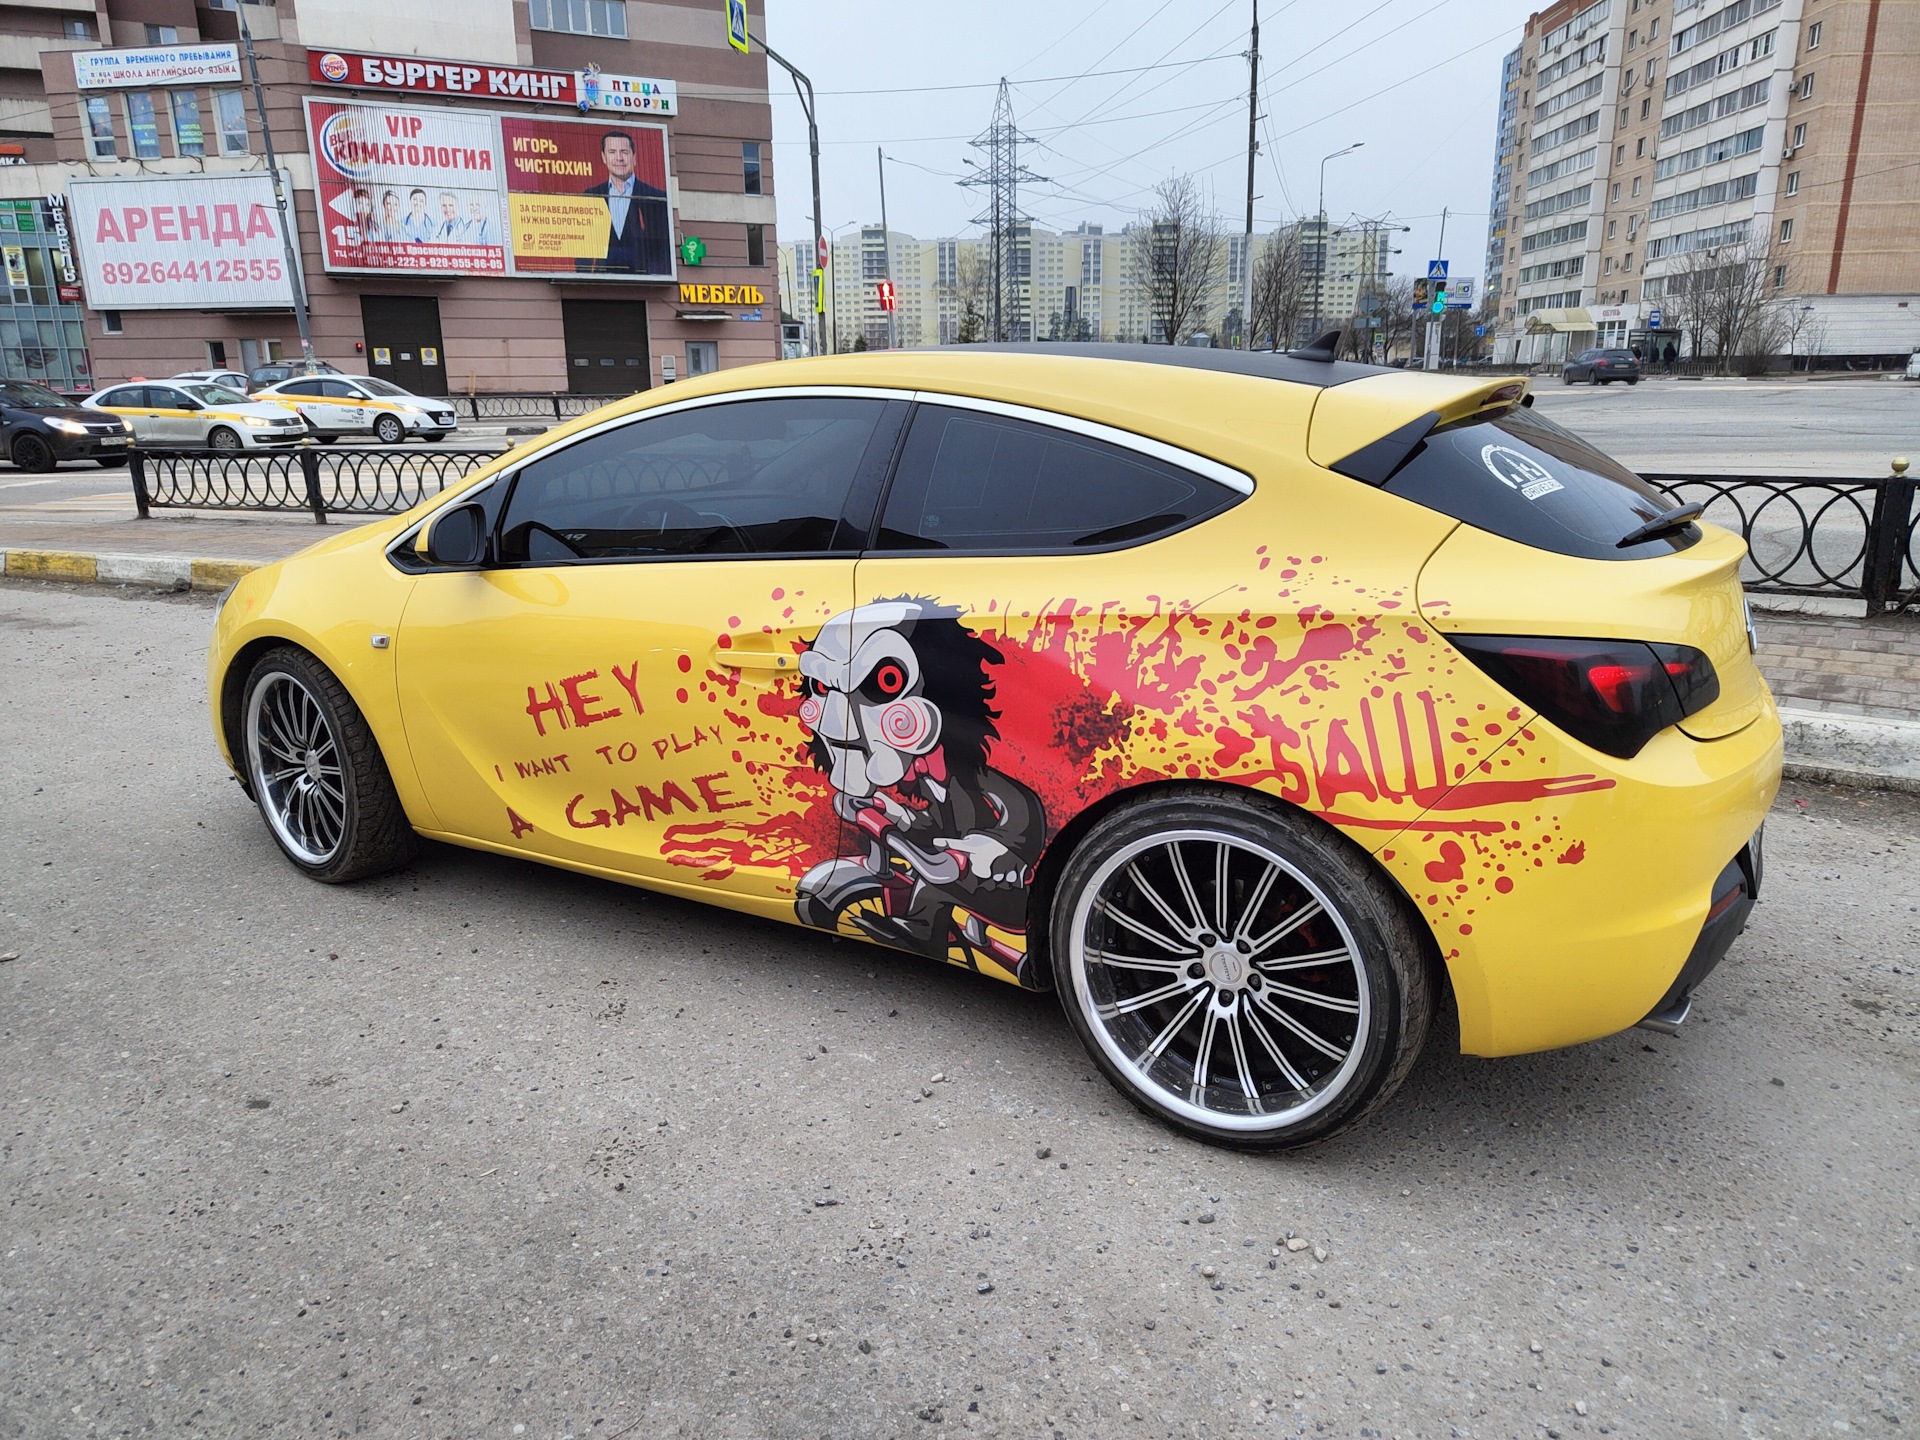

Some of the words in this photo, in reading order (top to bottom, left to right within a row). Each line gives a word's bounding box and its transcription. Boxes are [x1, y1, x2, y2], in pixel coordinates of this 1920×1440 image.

[90, 56, 120, 66] ГРУППА
[126, 53, 176, 64] ВРЕМЕННОГО
[179, 50, 232, 61] ПРЕБЫВАНИЯ
[112, 68, 143, 79] ШКОЛА
[145, 65, 204, 78] АНГЛИЙСКОГО
[208, 65, 237, 75] ЯЗЫКА
[362, 58, 481, 91] БУРГЕР
[487, 69, 568, 98] КИНГ
[612, 79, 661, 96] ПТИЦА
[605, 94, 670, 110] ГОВОРУН
[385, 115, 422, 138] VIP
[512, 136, 558, 154] ИГОРЬ
[514, 157, 593, 176] ЧИСТЮХИН
[519, 204, 531, 212] ЗА
[531, 205, 604, 216] СПРАВЕДЛИВОСТЬ
[96, 203, 276, 248] АРЕНДА
[520, 216, 550, 225] НУЖНО
[551, 217, 594, 227] БОРОТЬСЯ!
[47, 193, 77, 283] МЕБЕЛЬ
[331, 225, 362, 247] 15
[406, 245, 487, 258] Красноармейская
[487, 247, 502, 259] д.5
[102, 258, 282, 285] 89264412555
[679, 284, 765, 305] МЕБЕЛЬ
[882, 295, 896, 310] 77
[526, 660, 645, 737] HEY
[494, 765, 504, 782] I
[514, 754, 571, 779] WANT
[595, 741, 637, 765] TO
[651, 725, 723, 760] PLAY
[506, 806, 535, 839] A
[565, 770, 754, 829] GAME
